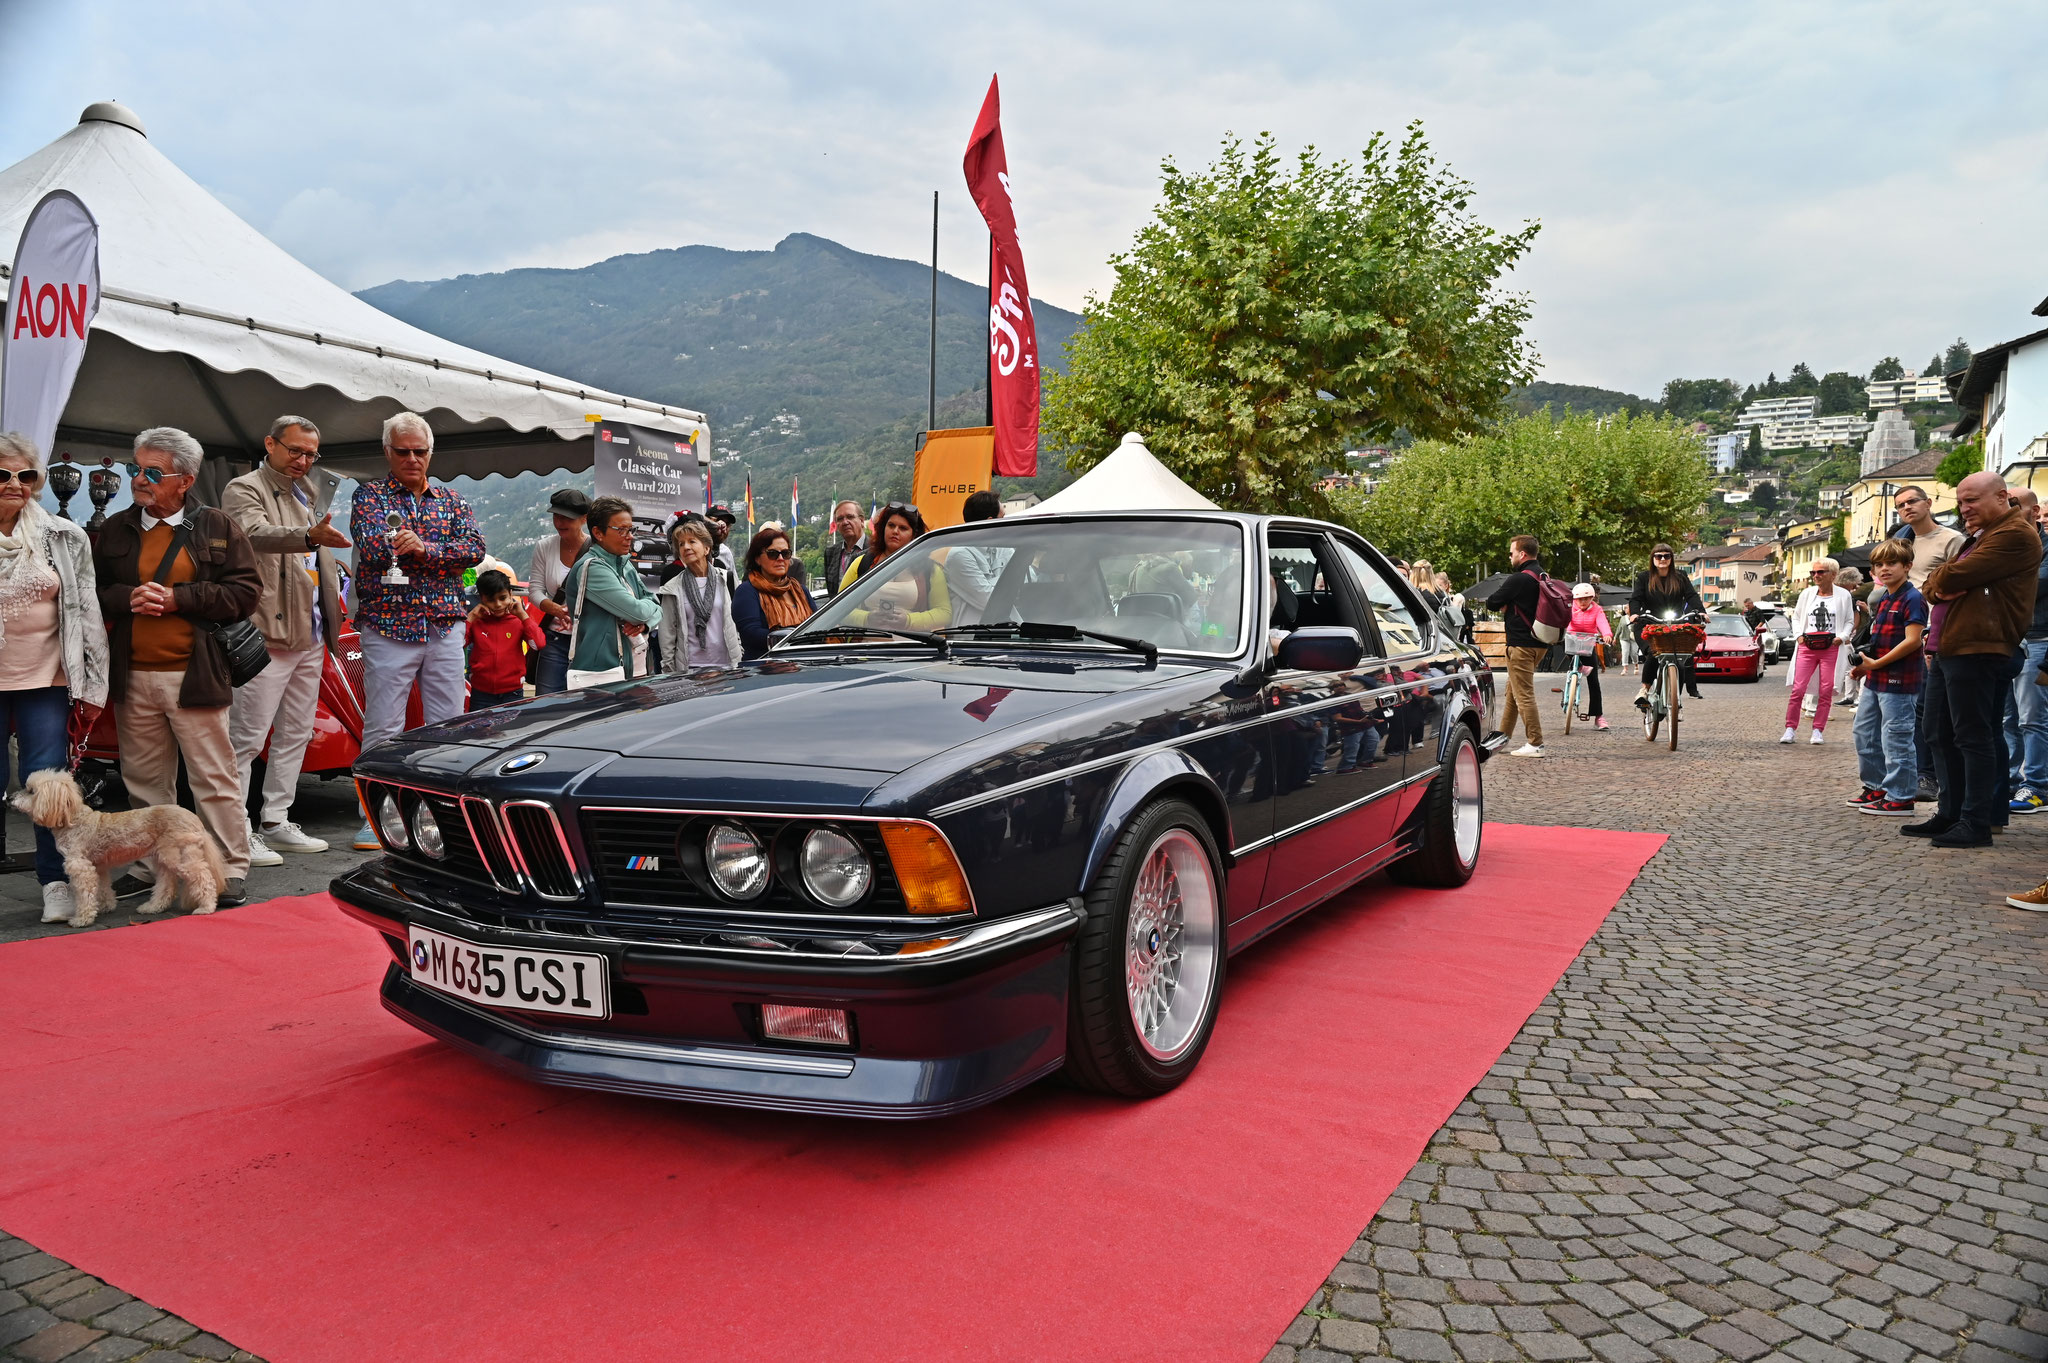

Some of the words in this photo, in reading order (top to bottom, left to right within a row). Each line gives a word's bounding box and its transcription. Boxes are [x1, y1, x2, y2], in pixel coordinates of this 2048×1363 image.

[13, 275, 87, 340] AON
[636, 445, 668, 461] Ascona
[617, 458, 661, 477] Classic
[663, 464, 683, 479] Car
[620, 478, 656, 493] Award
[657, 481, 682, 496] 2024
[931, 484, 976, 494] CHUBB
[514, 956, 593, 1009] CSI
